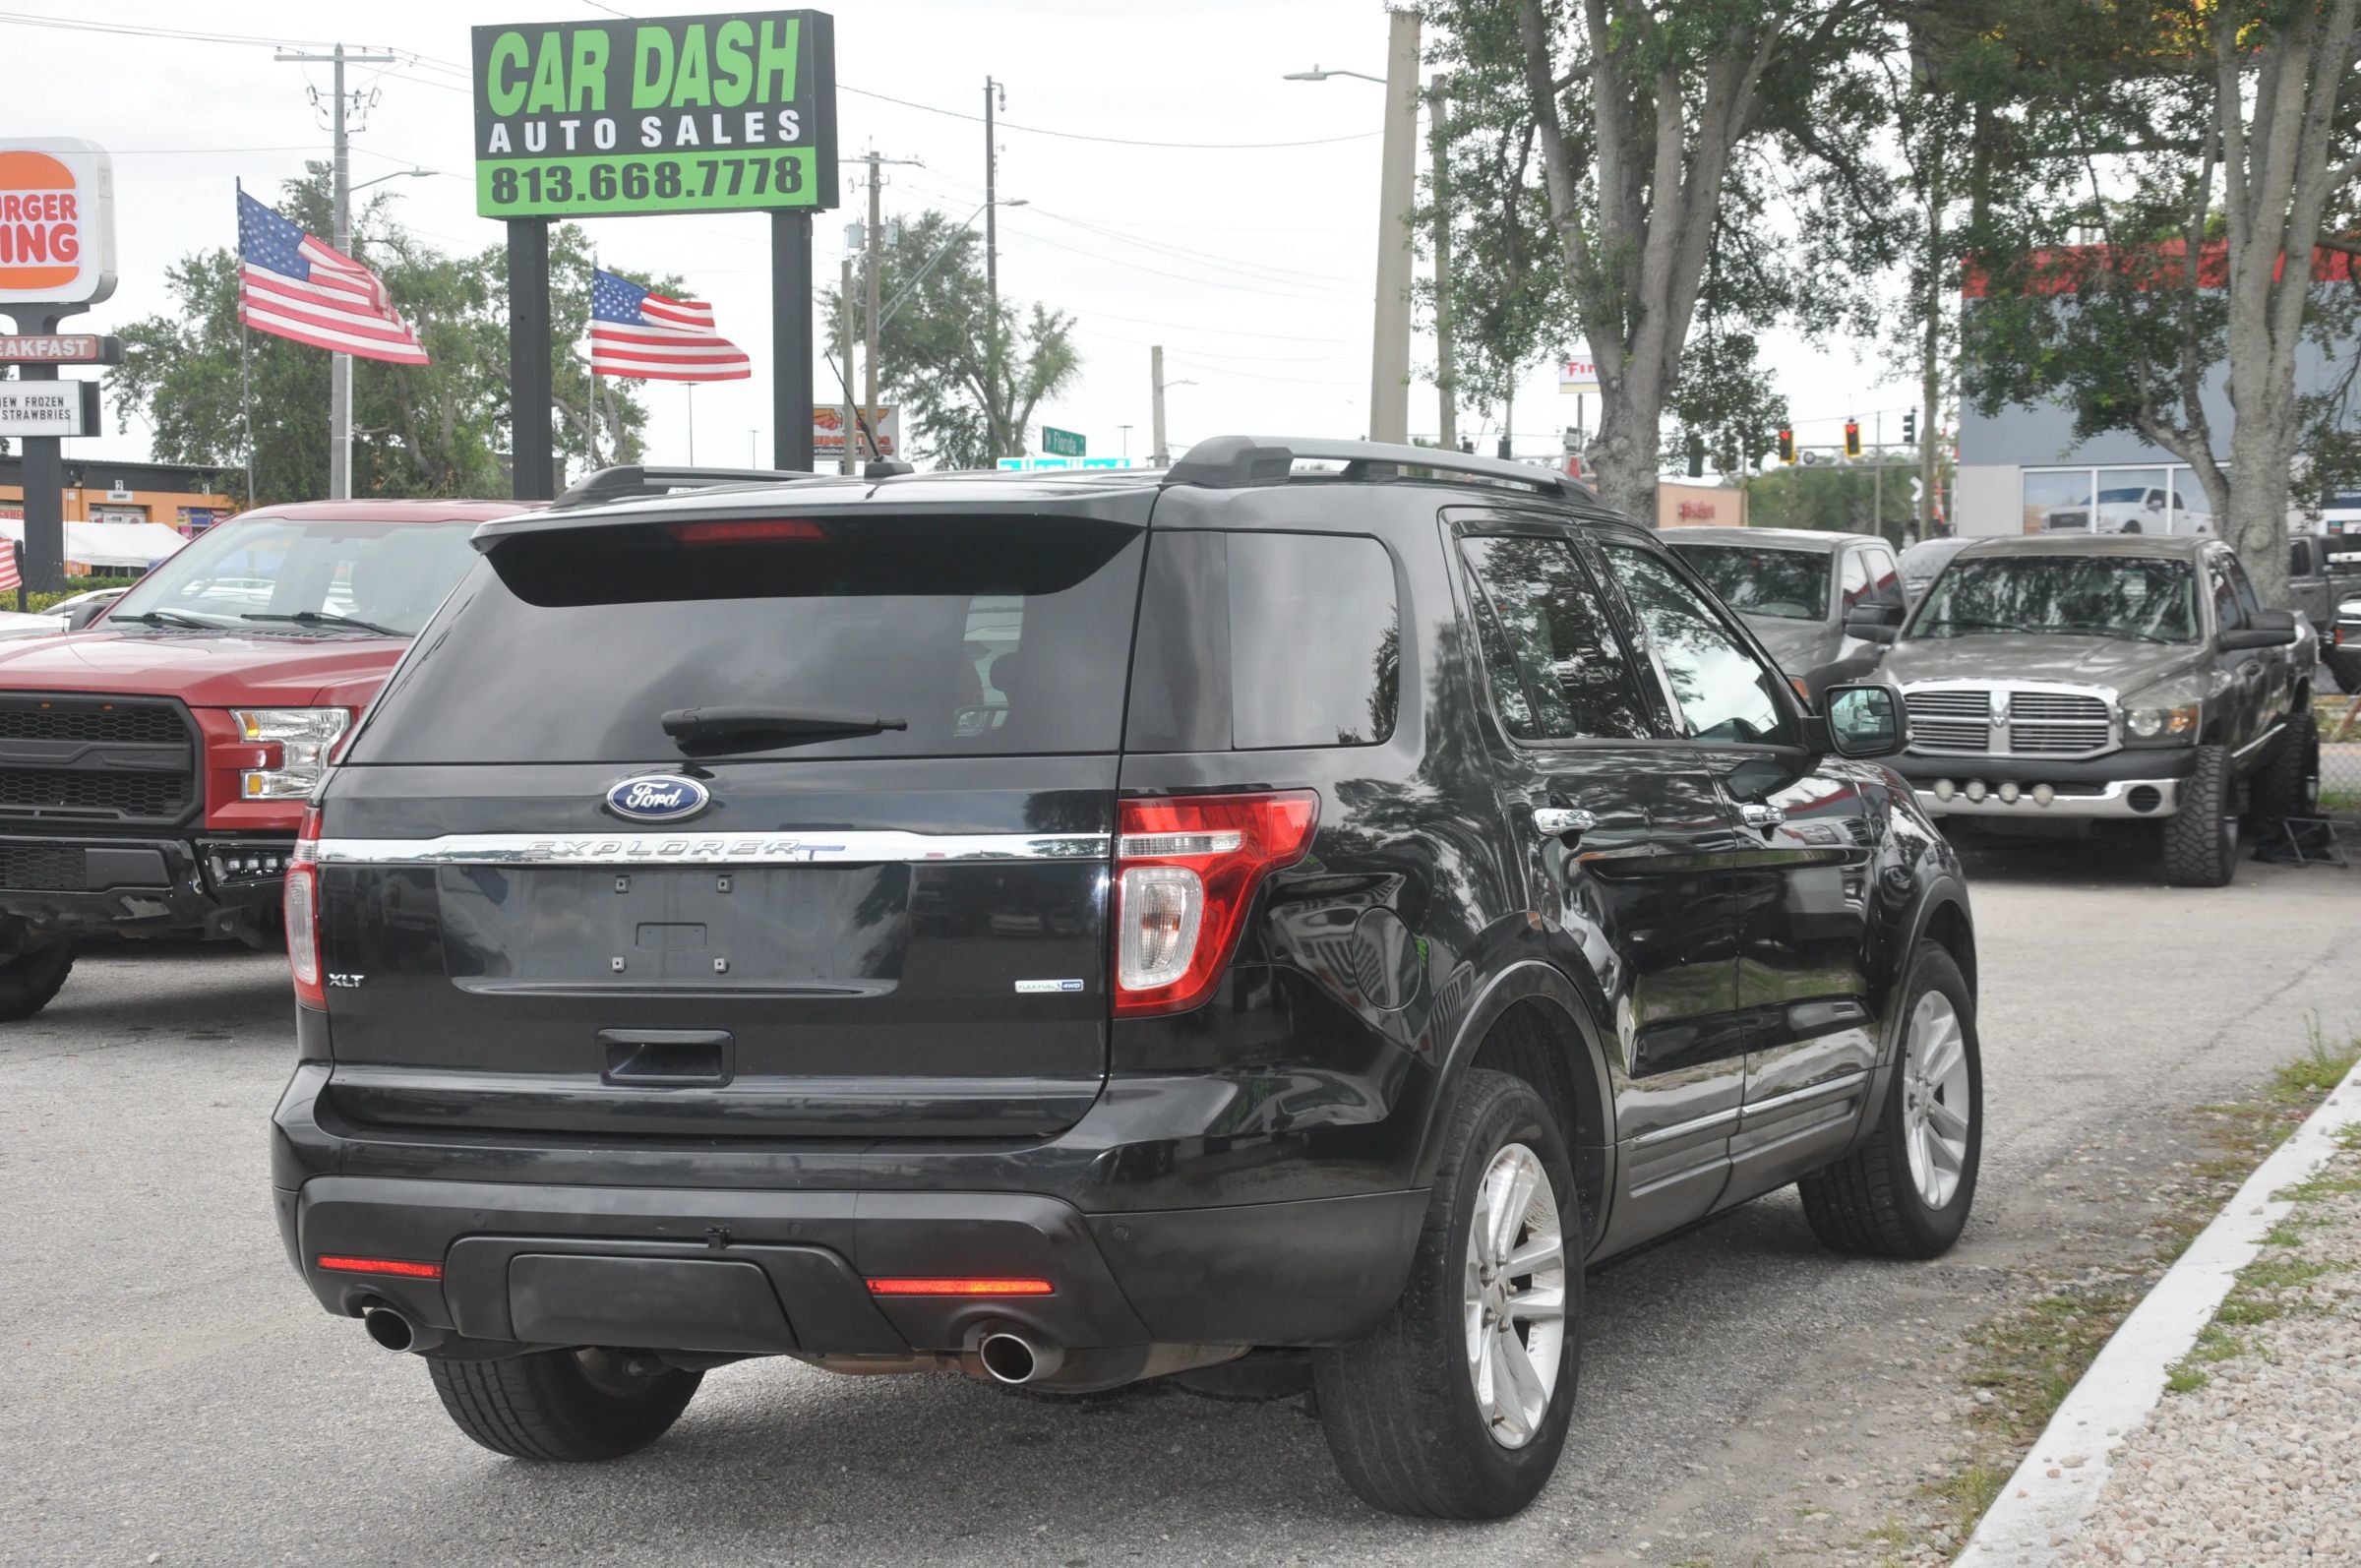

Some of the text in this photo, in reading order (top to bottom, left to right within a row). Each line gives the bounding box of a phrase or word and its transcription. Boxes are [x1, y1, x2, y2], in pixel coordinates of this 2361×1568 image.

[487, 18, 800, 117] CAR DASH
[488, 109, 801, 153] AUTO SALES
[491, 155, 803, 205] 813.668.7778
[0, 194, 78, 222] RGER
[0, 396, 64, 407] EW FROZEN
[2, 409, 71, 421] STRAWBRIES
[1055, 431, 1077, 454] Florida
[626, 782, 683, 809] Ford
[519, 839, 800, 859] EXPLORER
[328, 973, 365, 988] XLT
